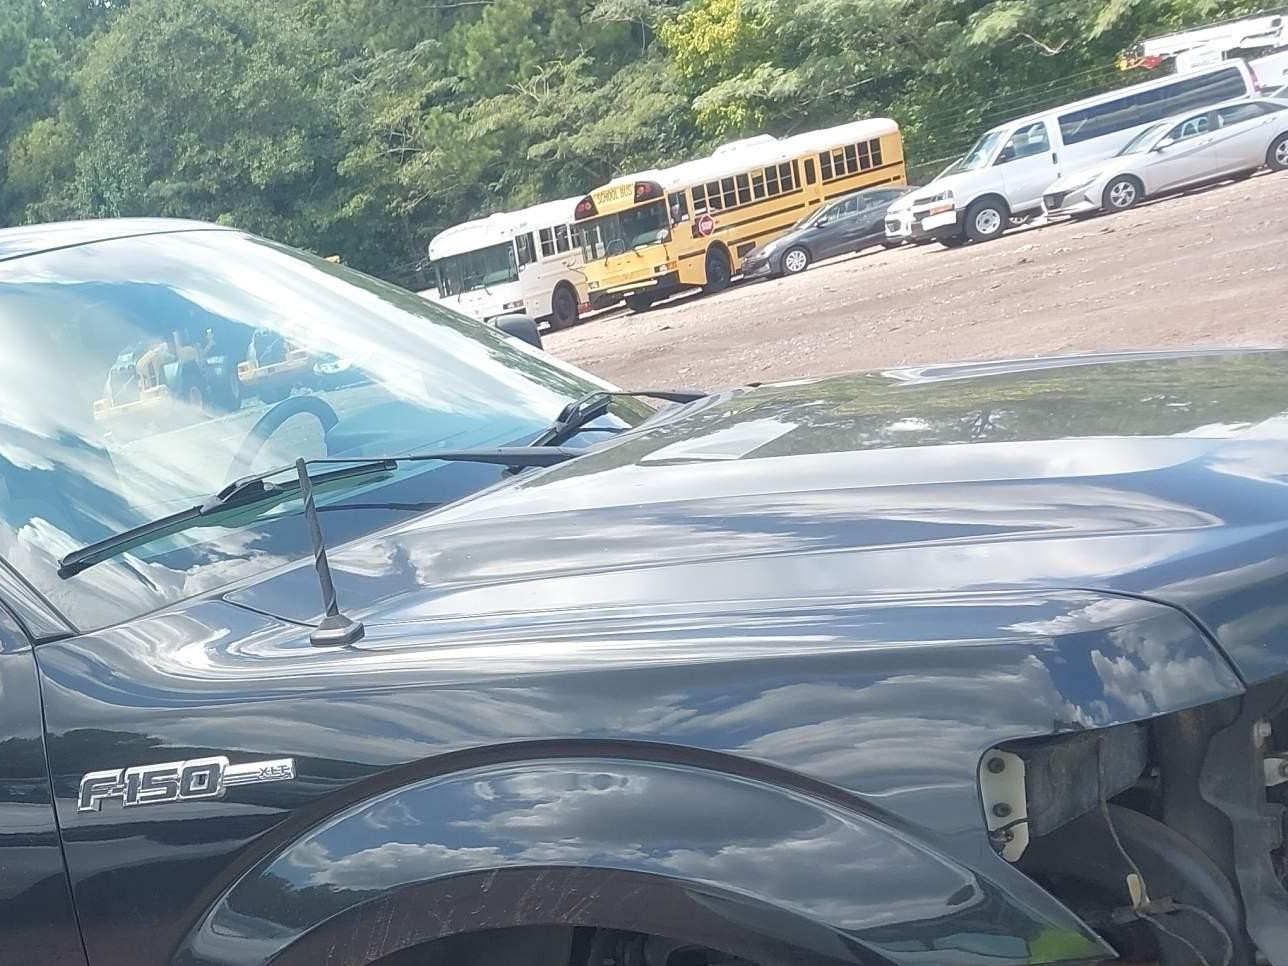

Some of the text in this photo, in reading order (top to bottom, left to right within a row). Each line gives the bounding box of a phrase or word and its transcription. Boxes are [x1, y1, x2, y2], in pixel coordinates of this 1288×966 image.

[595, 183, 634, 205] SCHOOL BUS
[77, 755, 291, 813] F-150 XLT
